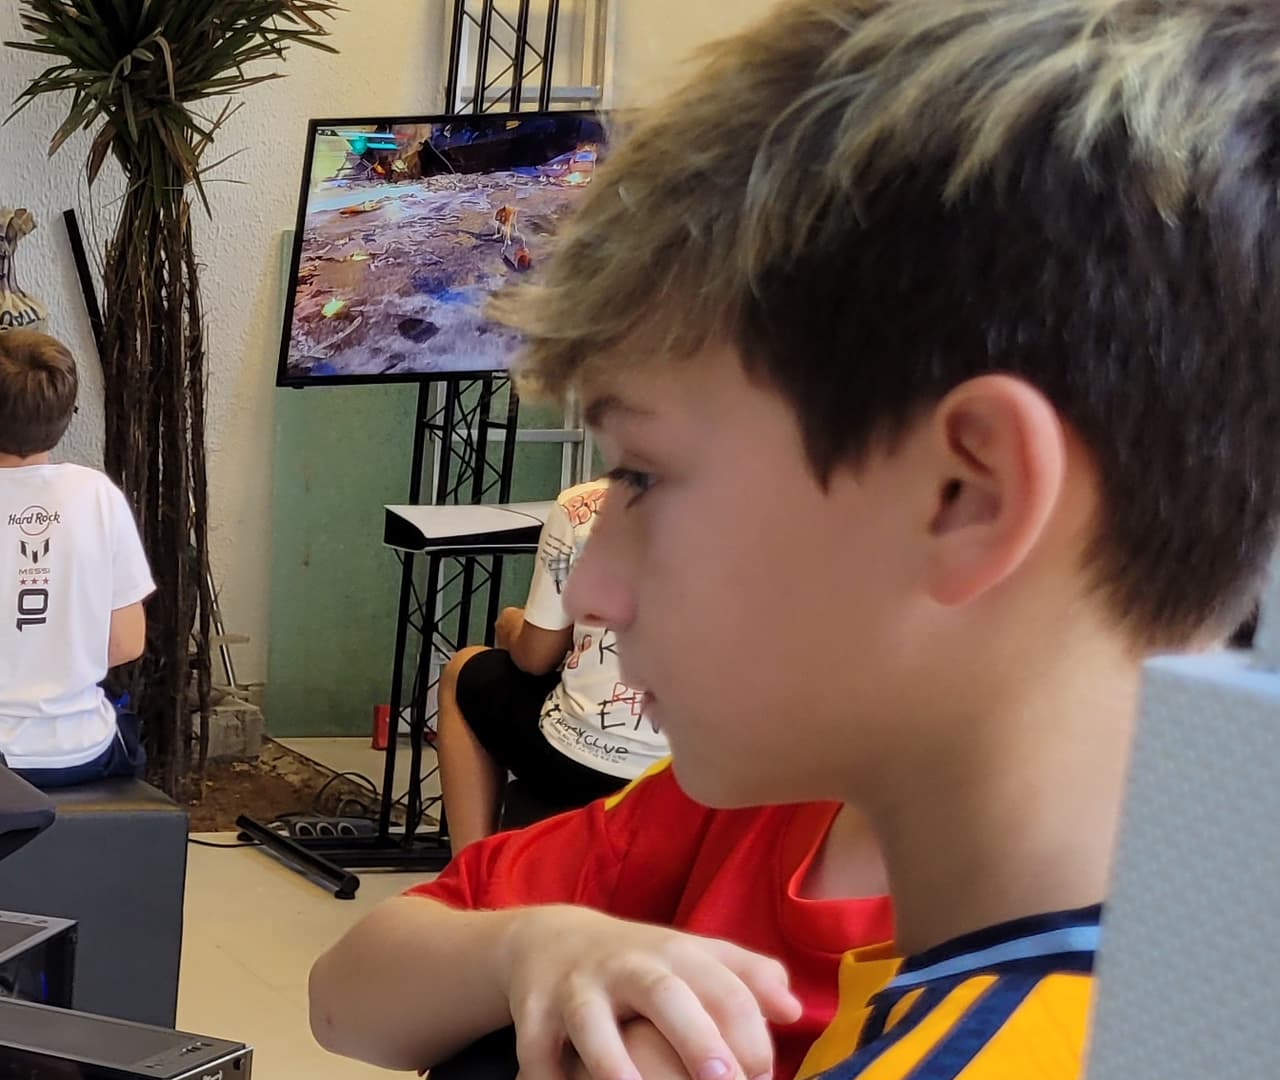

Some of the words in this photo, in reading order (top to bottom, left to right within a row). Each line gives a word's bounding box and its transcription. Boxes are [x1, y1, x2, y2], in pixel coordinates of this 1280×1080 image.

[7, 512, 34, 526] Hard
[35, 511, 61, 526] Rock
[18, 567, 50, 576] MESSI
[16, 588, 49, 633] 10
